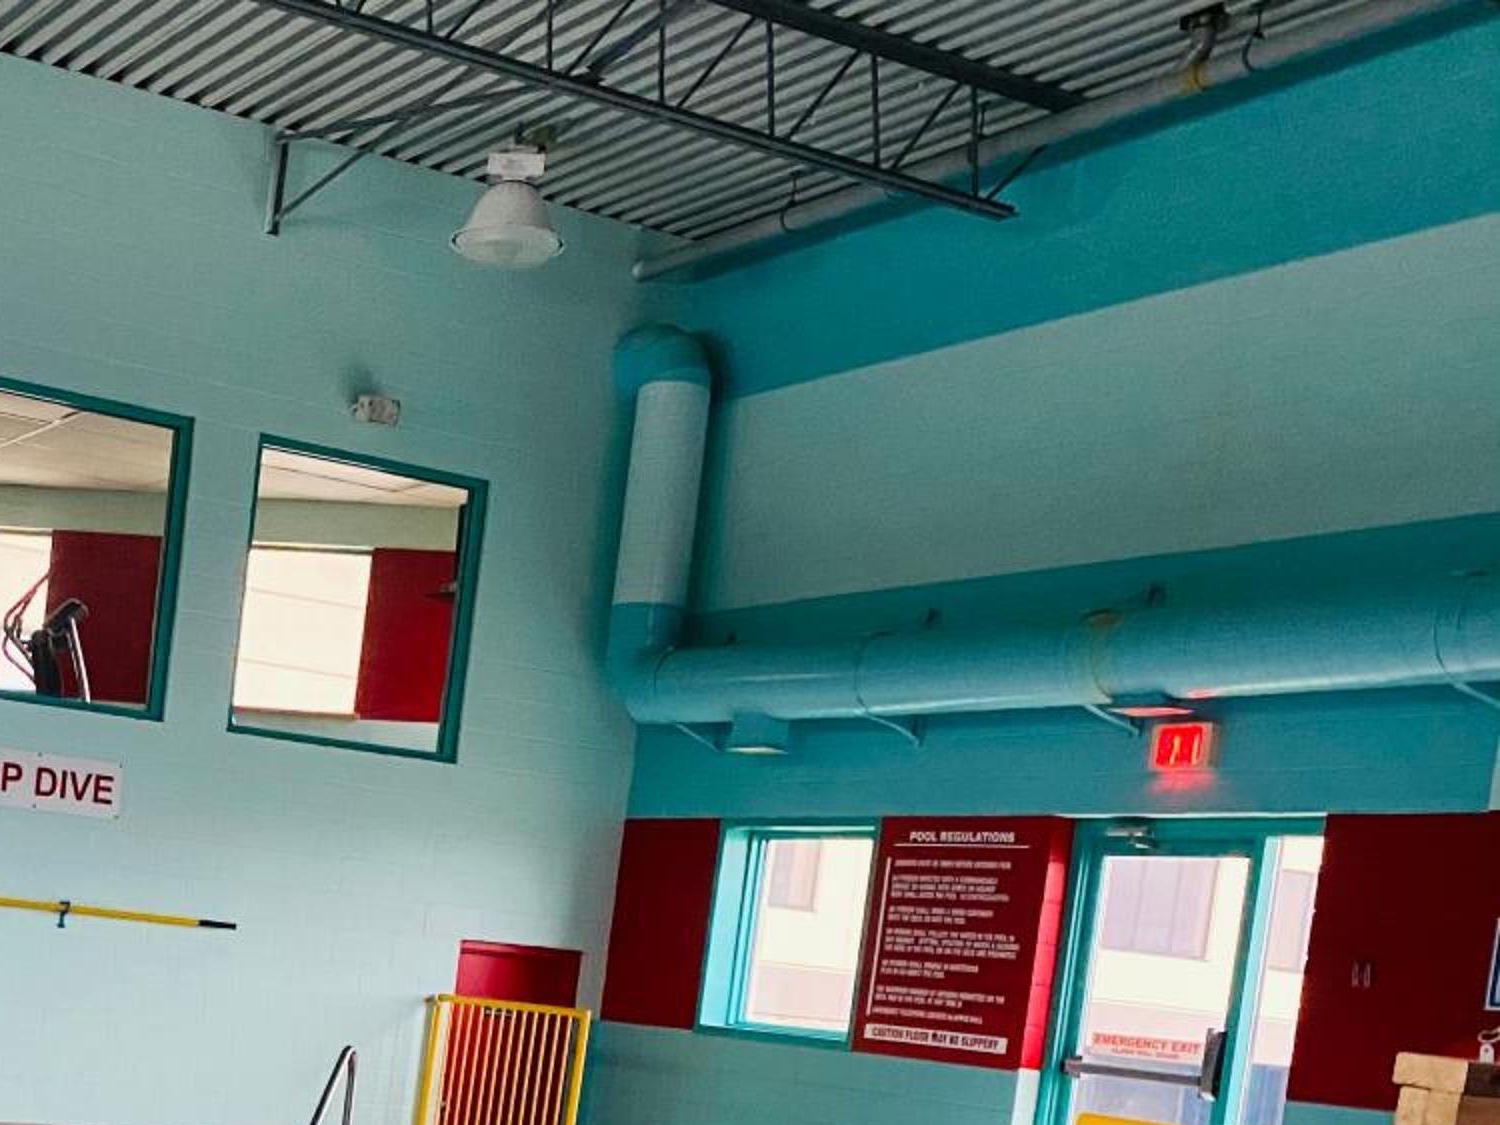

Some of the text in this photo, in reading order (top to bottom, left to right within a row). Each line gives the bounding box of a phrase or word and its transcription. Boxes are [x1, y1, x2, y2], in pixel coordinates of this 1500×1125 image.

[34, 767, 115, 805] DIVE
[909, 831, 1015, 843] POOL REGULATIONS
[1092, 1033, 1201, 1053] EMERGENCY EXIT
